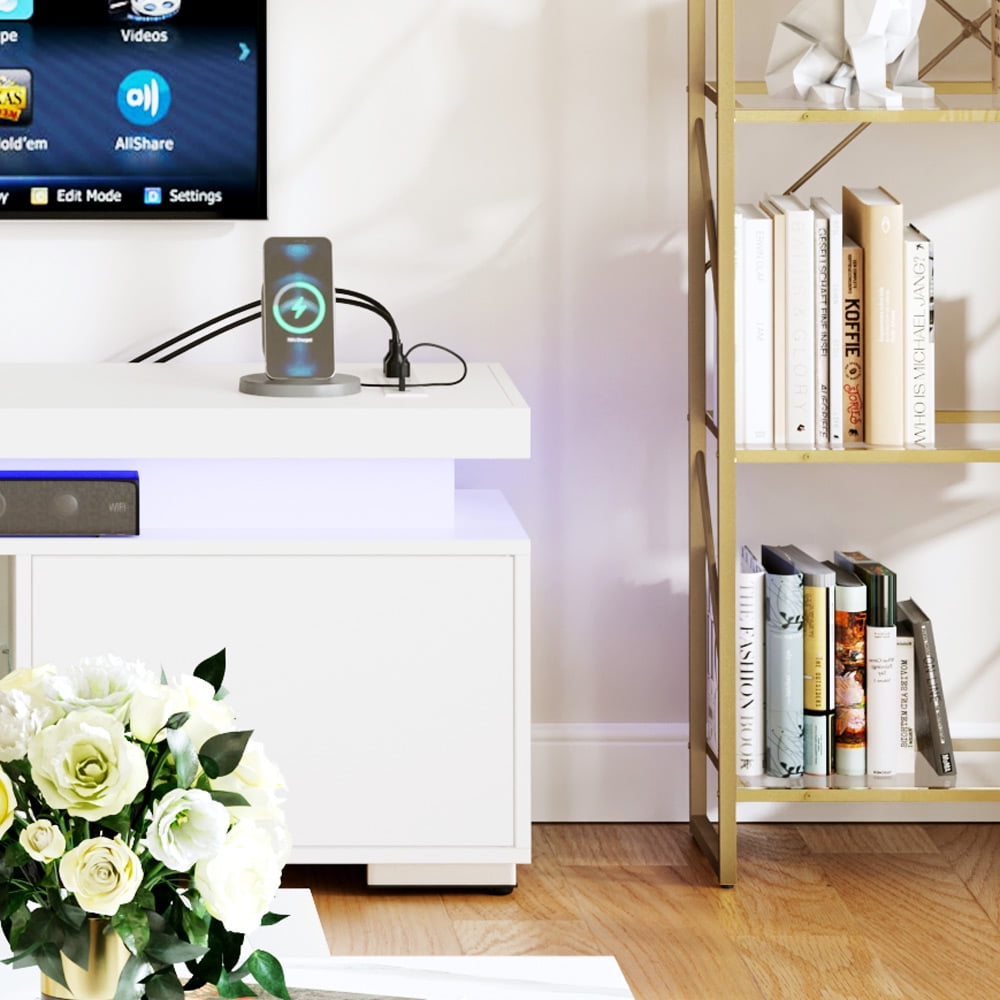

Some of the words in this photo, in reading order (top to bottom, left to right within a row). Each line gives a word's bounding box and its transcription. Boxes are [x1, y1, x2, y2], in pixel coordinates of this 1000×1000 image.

[121, 29, 169, 42] Videos
[115, 136, 174, 150] AllShare
[57, 189, 82, 203] Edit
[86, 189, 122, 203] Mode
[169, 189, 222, 205] Settings
[914, 256, 926, 307] JANG?
[845, 299, 860, 358] KOFFIE
[914, 311, 926, 380] MICHAEL
[843, 384, 862, 425] STORIES
[914, 384, 926, 397] IS
[914, 402, 926, 448] WHO
[739, 585, 755, 622] THE
[739, 627, 755, 710] FASHION
[739, 716, 755, 769] BOOK
